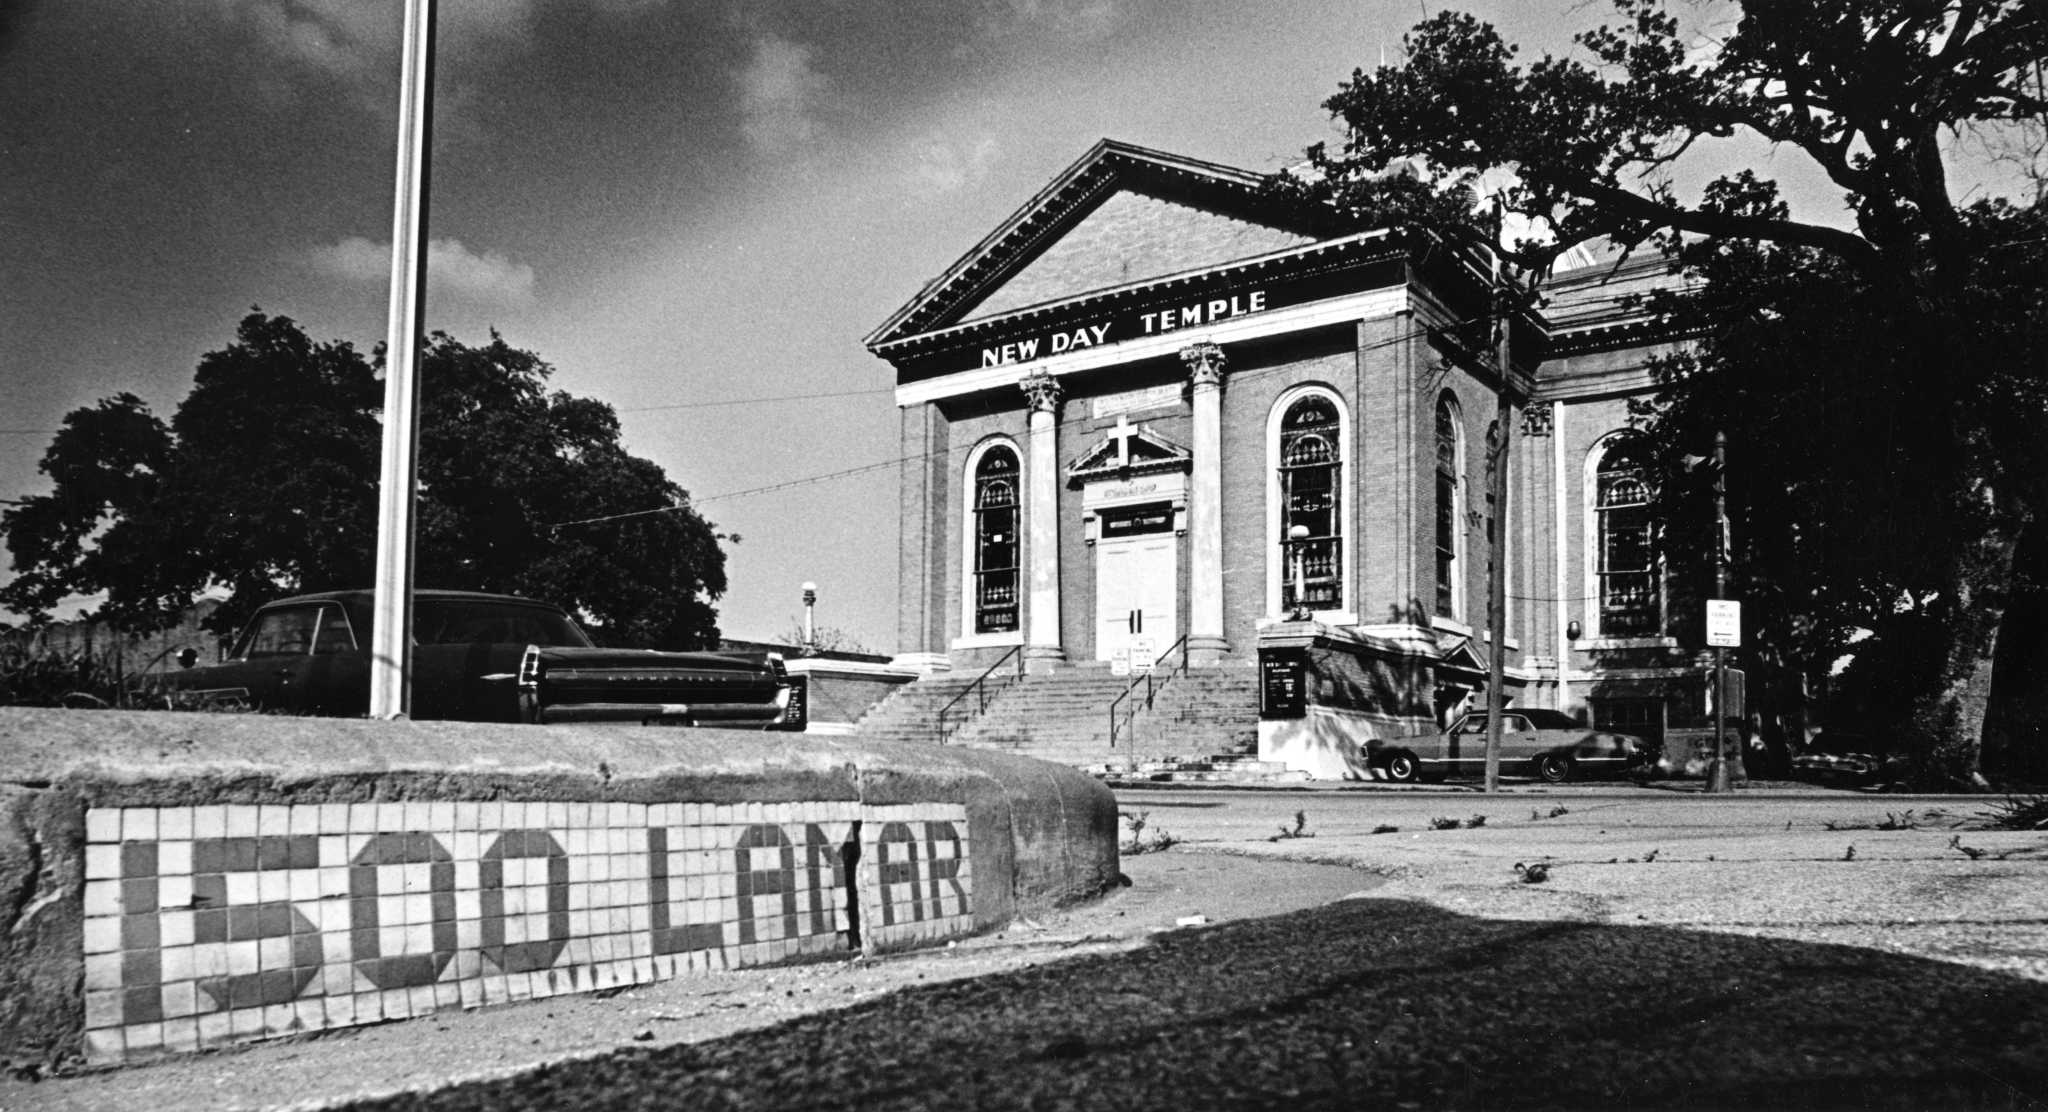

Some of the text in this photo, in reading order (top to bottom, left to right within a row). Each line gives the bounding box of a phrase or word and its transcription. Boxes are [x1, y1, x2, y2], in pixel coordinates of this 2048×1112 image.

[981, 290, 1266, 369] NEW DAY TEMPLE
[120, 820, 968, 1025] 1500 LAMAR
